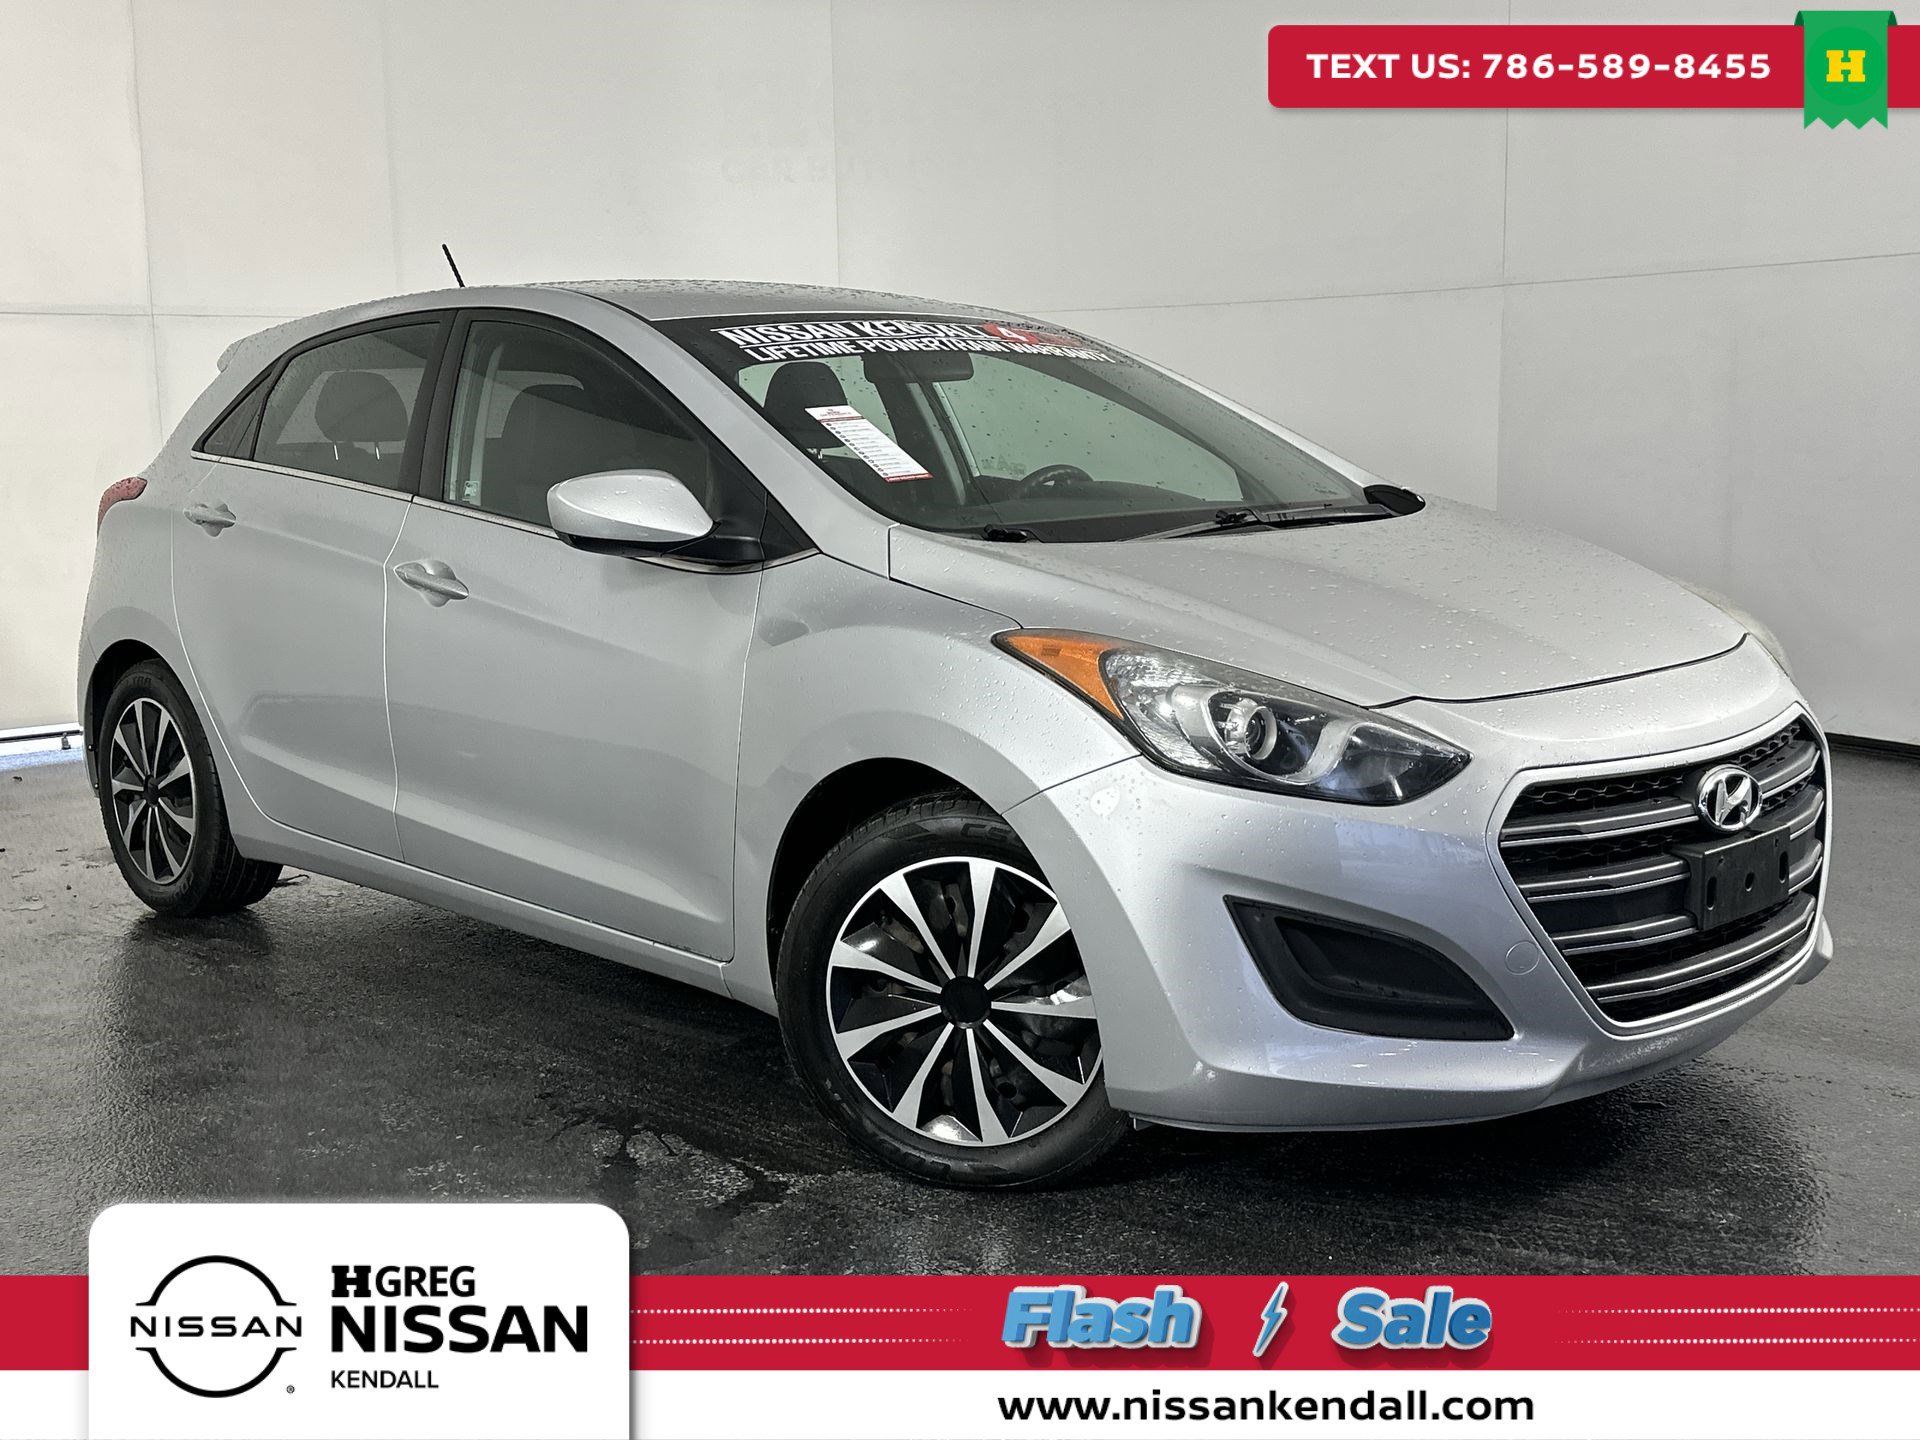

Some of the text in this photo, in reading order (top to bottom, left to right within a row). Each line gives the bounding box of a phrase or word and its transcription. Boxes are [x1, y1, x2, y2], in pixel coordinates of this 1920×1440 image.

[717, 322, 861, 346] NISSAN
[852, 319, 1001, 339] KENDALL
[743, 340, 865, 362] LIFETIME
[857, 338, 1011, 353] POWERTRAIN
[1008, 342, 1116, 363] WARRANTY
